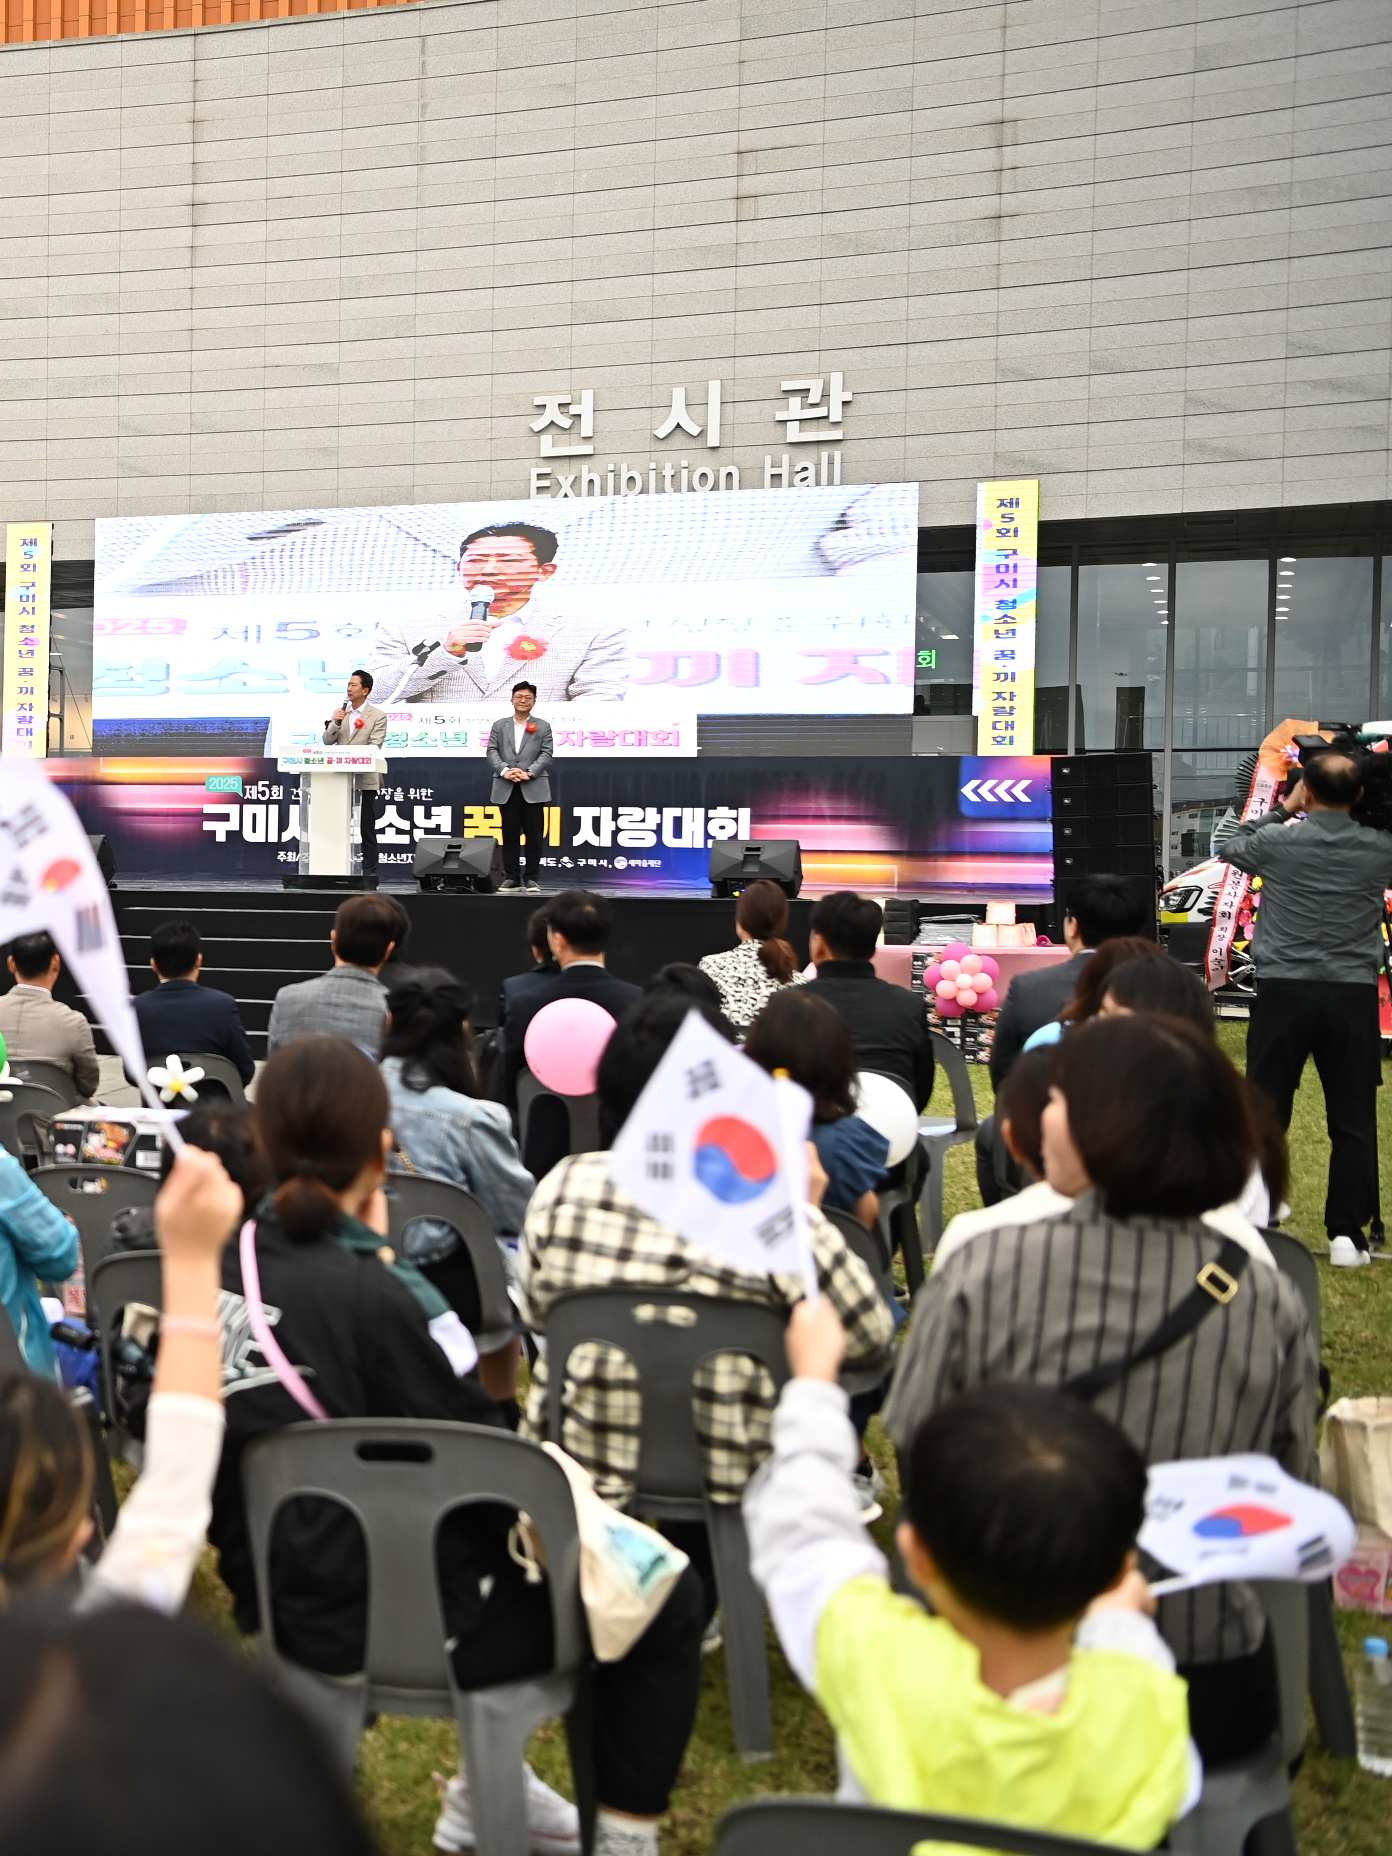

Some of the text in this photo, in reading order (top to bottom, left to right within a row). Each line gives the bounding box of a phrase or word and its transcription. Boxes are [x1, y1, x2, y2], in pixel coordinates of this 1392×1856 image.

[529, 450, 843, 499] Exhibition Hall
[995, 497, 1020, 538] 제5회
[19, 537, 38, 573] 제5회
[994, 548, 1018, 589] 구미시
[18, 581, 37, 616] 구미시
[993, 598, 1018, 639] 청소년
[17, 624, 36, 659] 청소년
[15, 702, 35, 751] 자랑대회
[384, 731, 468, 748] 청소년
[555, 729, 680, 748] 자랑대회
[990, 690, 1018, 746] 자랑대회
[209, 777, 238, 791] 2025
[244, 781, 283, 800] 제5회
[408, 788, 434, 801] 위한
[572, 806, 751, 849] 자랑대회
